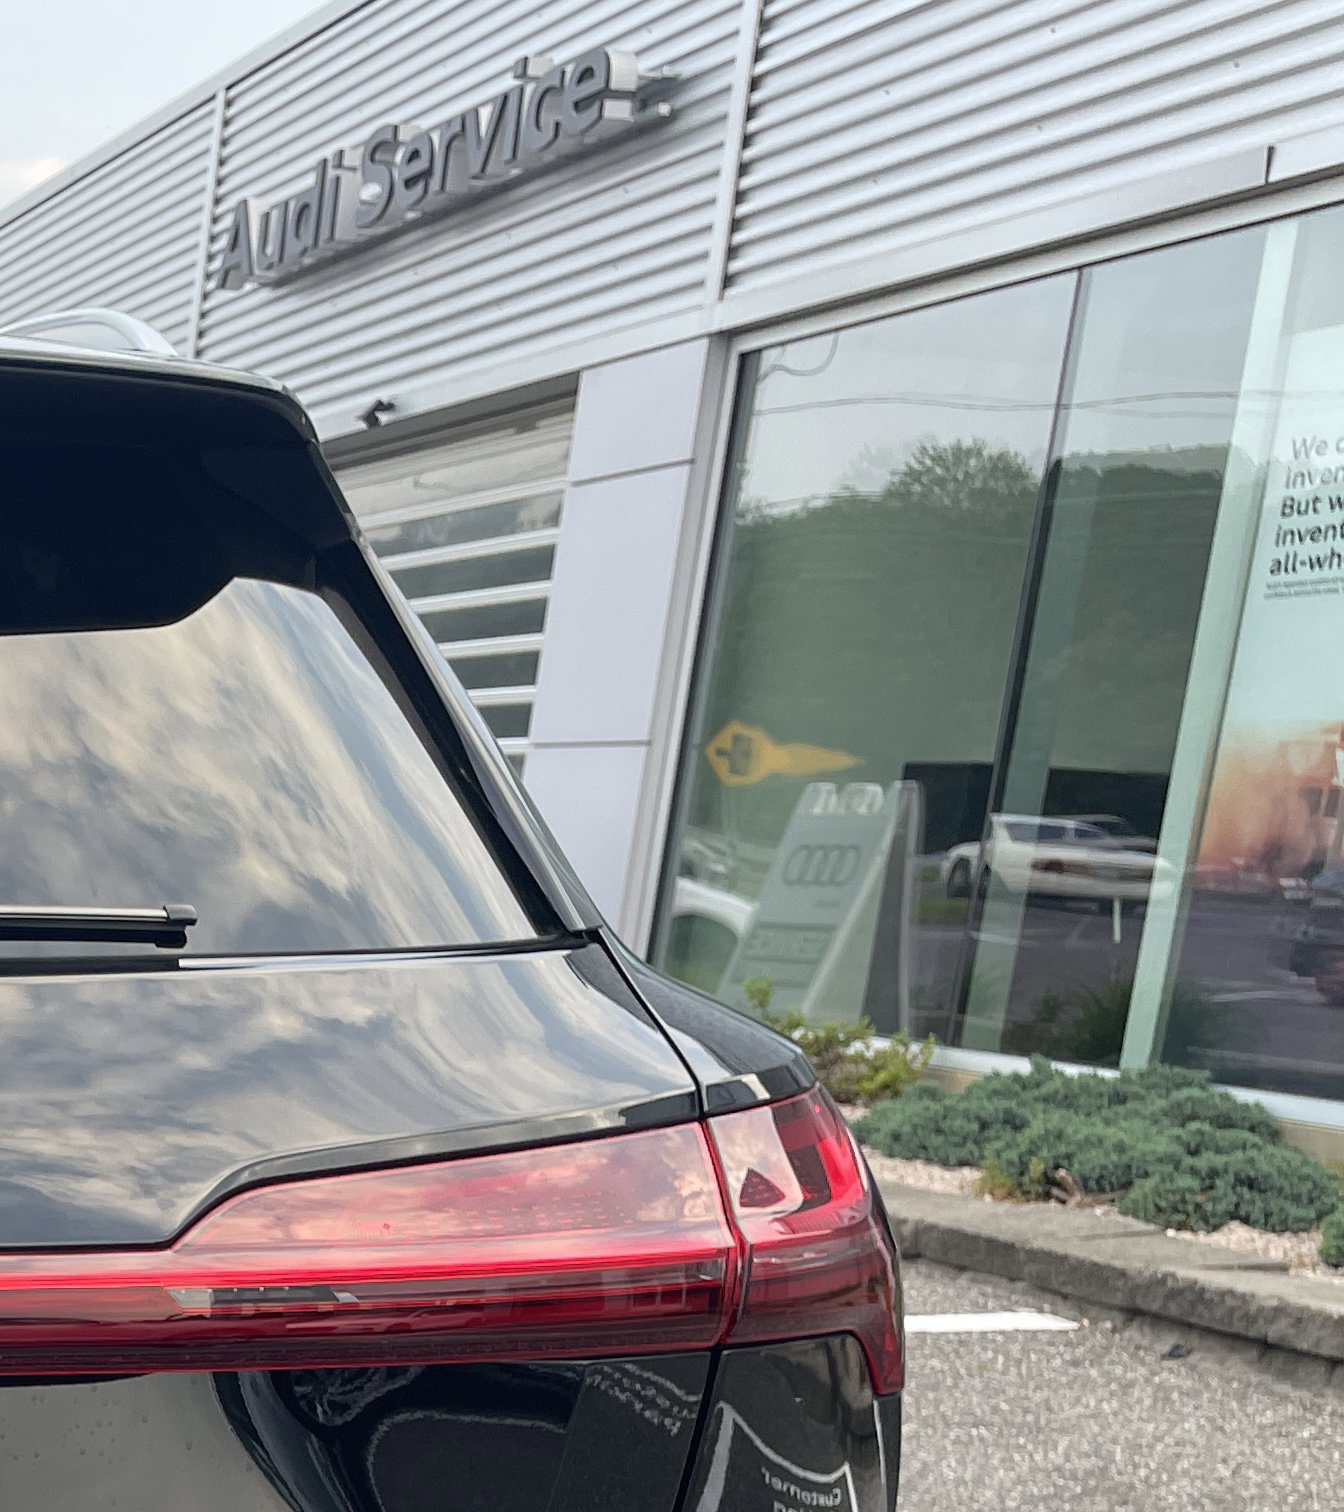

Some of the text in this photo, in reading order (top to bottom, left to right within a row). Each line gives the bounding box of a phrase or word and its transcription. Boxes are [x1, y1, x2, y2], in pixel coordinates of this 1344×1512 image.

[215, 46, 614, 290] Audi Service
[1291, 435, 1328, 461] We
[1280, 493, 1322, 518] But
